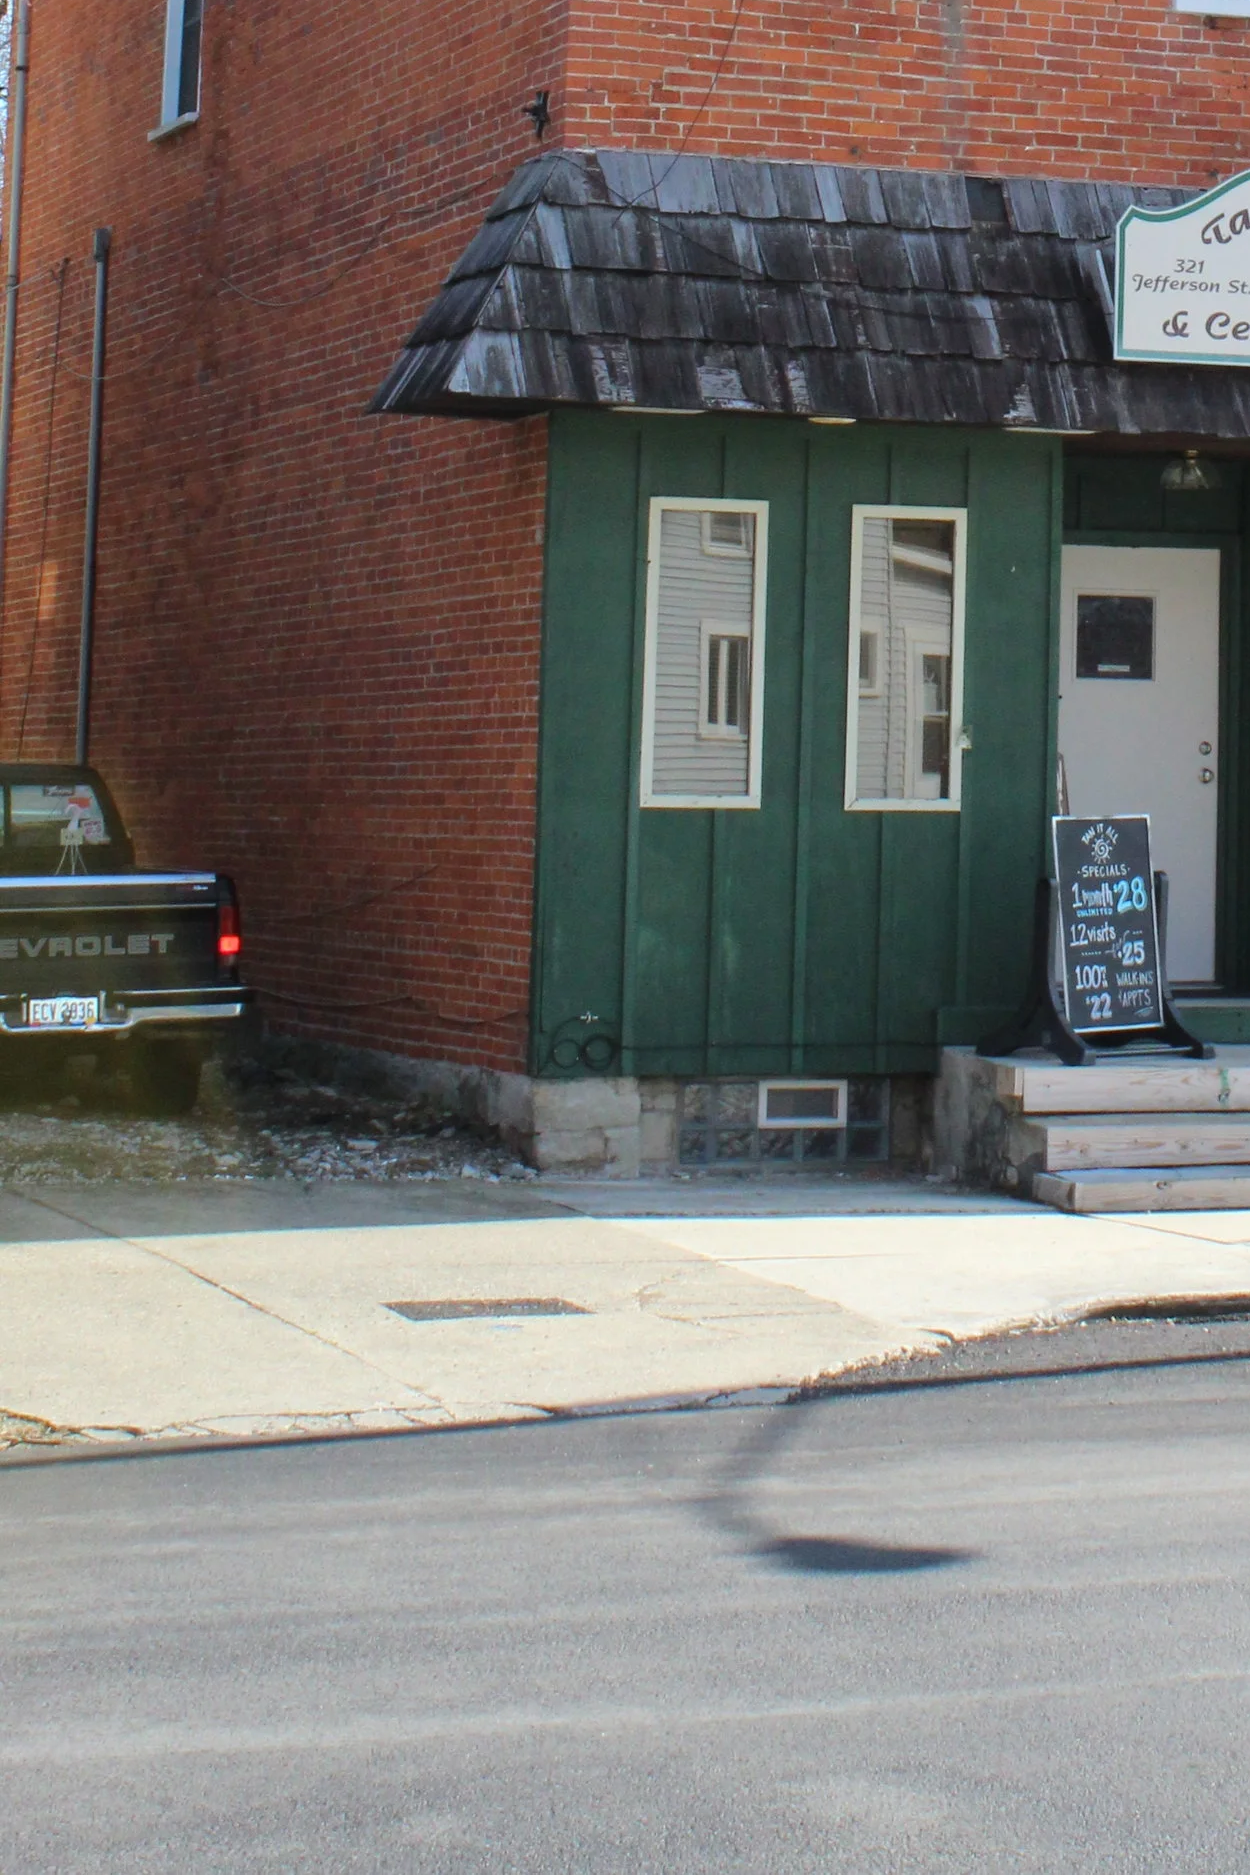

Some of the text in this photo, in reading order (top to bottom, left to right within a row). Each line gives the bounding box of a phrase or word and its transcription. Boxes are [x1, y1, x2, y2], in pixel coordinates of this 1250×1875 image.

[1173, 258, 1205, 275] 321
[1132, 273, 1221, 294] Jefferson
[1162, 309, 1190, 339] &
[1081, 823, 1120, 845] TAN IT ALL
[1081, 864, 1128, 878] SPECIALS
[1071, 882, 1083, 909] 1
[1069, 921, 1117, 947] 12 visits
